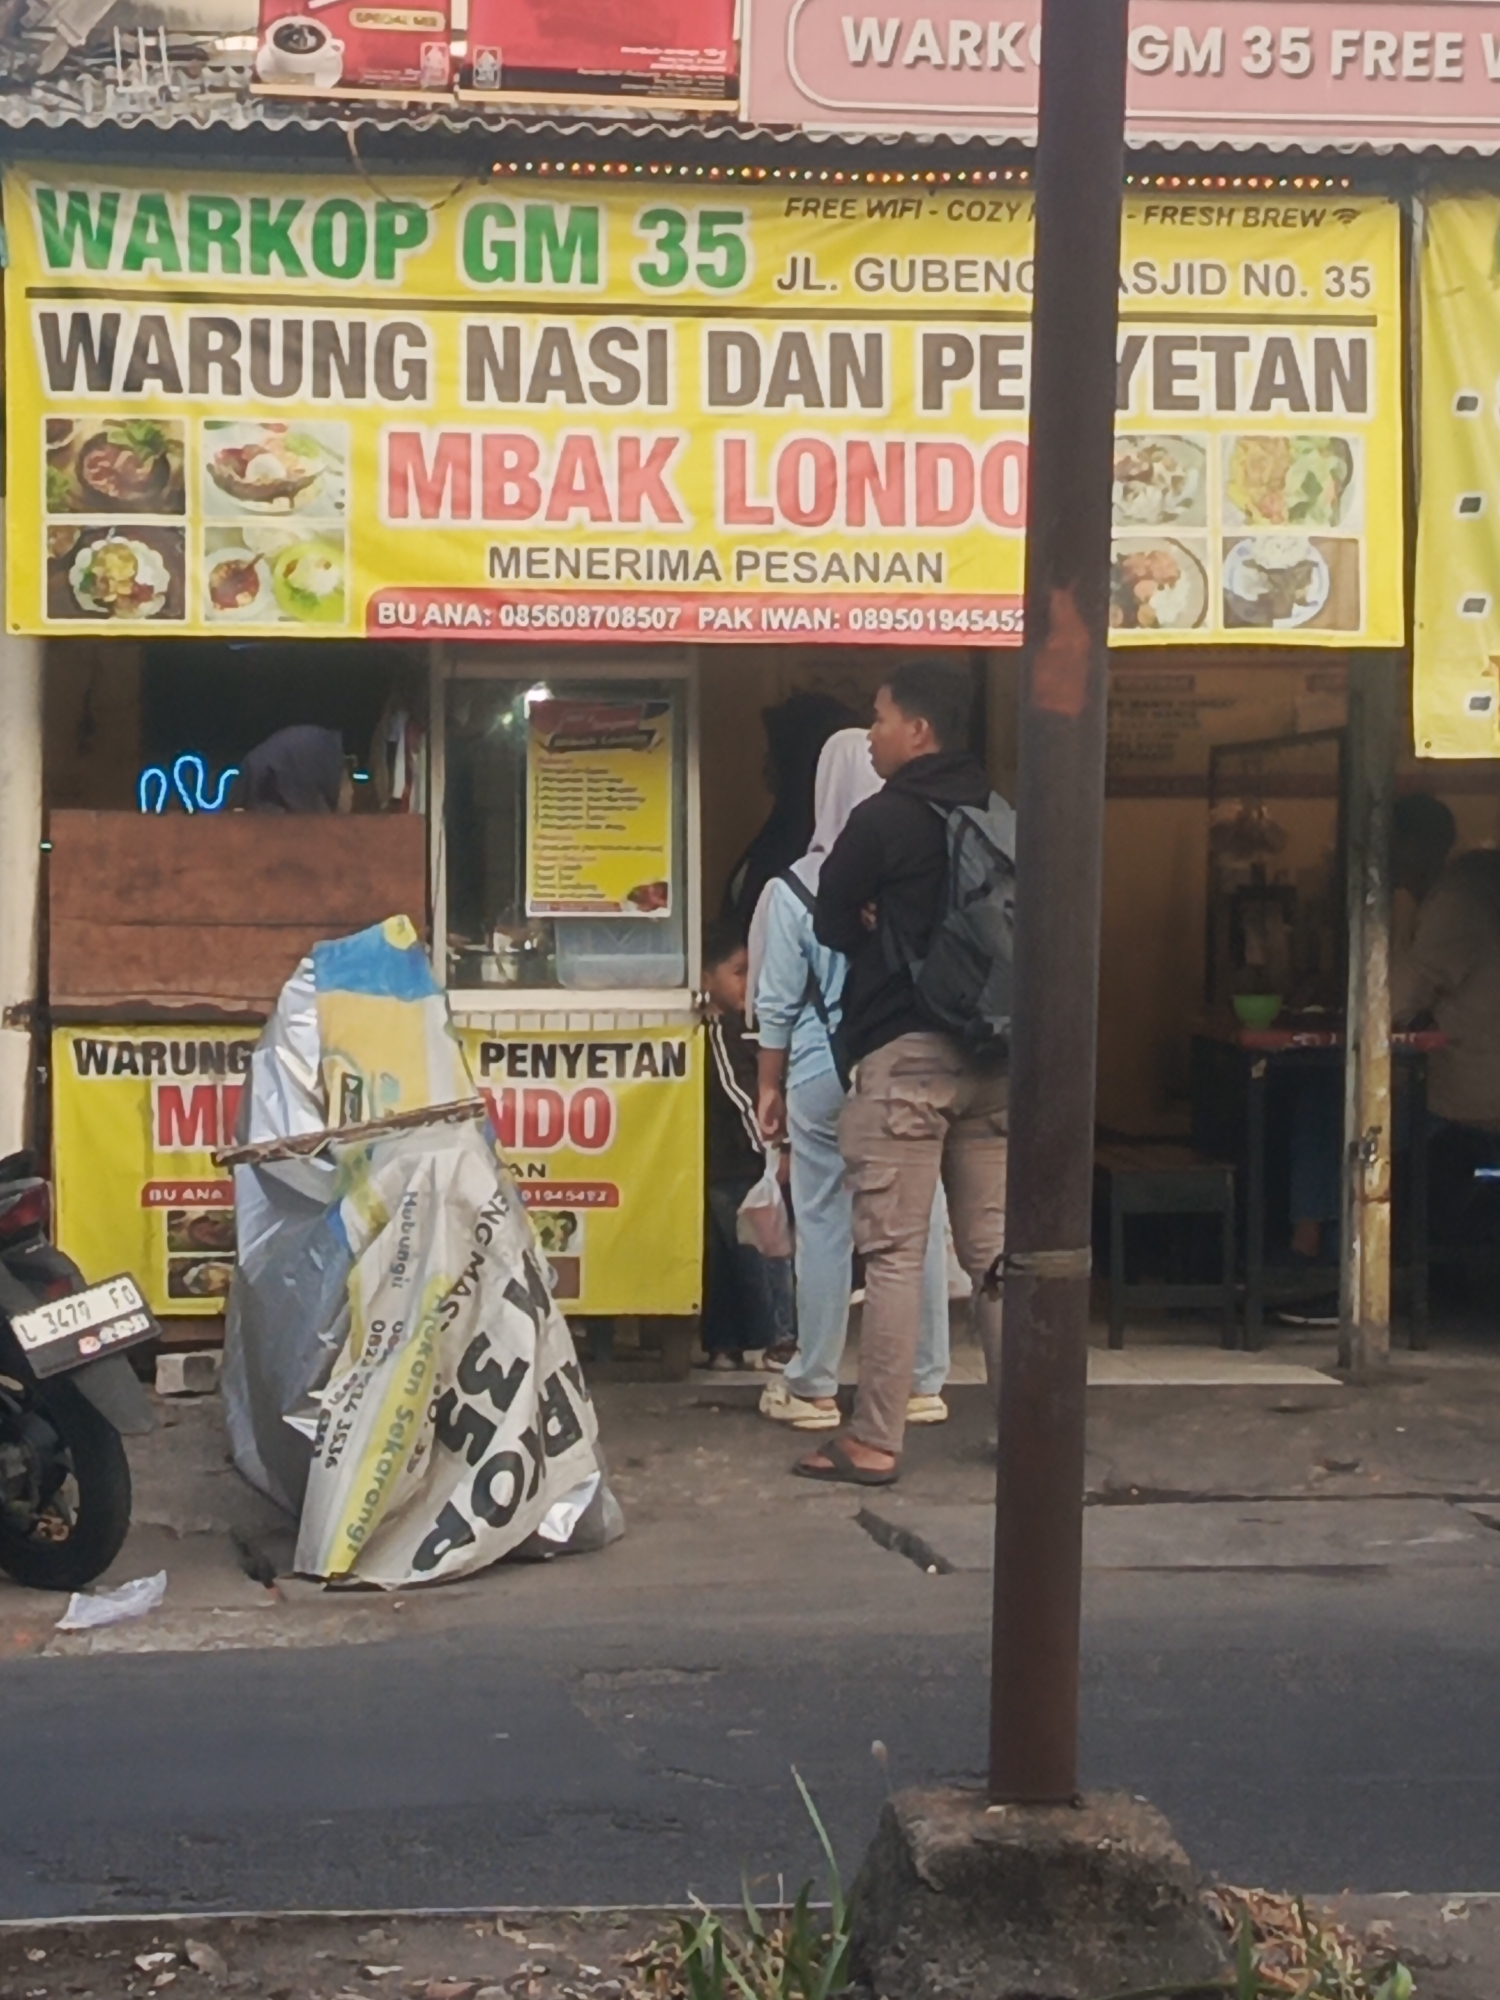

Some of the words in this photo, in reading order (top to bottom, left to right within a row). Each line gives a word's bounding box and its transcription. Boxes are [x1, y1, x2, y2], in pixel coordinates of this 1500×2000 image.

[842, 17, 1041, 69] WARK
[1128, 25, 1224, 74] GM
[1241, 26, 1313, 76] 35
[1331, 29, 1465, 80] FREE
[784, 197, 857, 220] FREE
[866, 198, 922, 221] WIFI
[947, 200, 1022, 223] COZY
[1144, 205, 1236, 227] FRESH
[1242, 207, 1327, 228] BREW
[35, 187, 429, 279] WARKOP
[463, 203, 600, 285] GM
[638, 208, 746, 290] 35
[777, 257, 838, 291] JL.
[1325, 265, 1371, 299] 35
[39, 312, 428, 401] WARUNG
[467, 325, 669, 406] NASI
[707, 330, 883, 410] DAN
[386, 431, 685, 524] MBAK
[488, 547, 722, 582] MENERIMA
[735, 550, 943, 584] PESANAN
[378, 602, 416, 625] BU
[422, 603, 492, 627] ANA:
[500, 604, 682, 630] 085608708507
[697, 606, 754, 631] PAK
[761, 607, 841, 632] IWAN:
[73, 1038, 253, 1076] WARUNG
[480, 1041, 686, 1079] PENYETAN
[434, 1331, 531, 1467] 35
